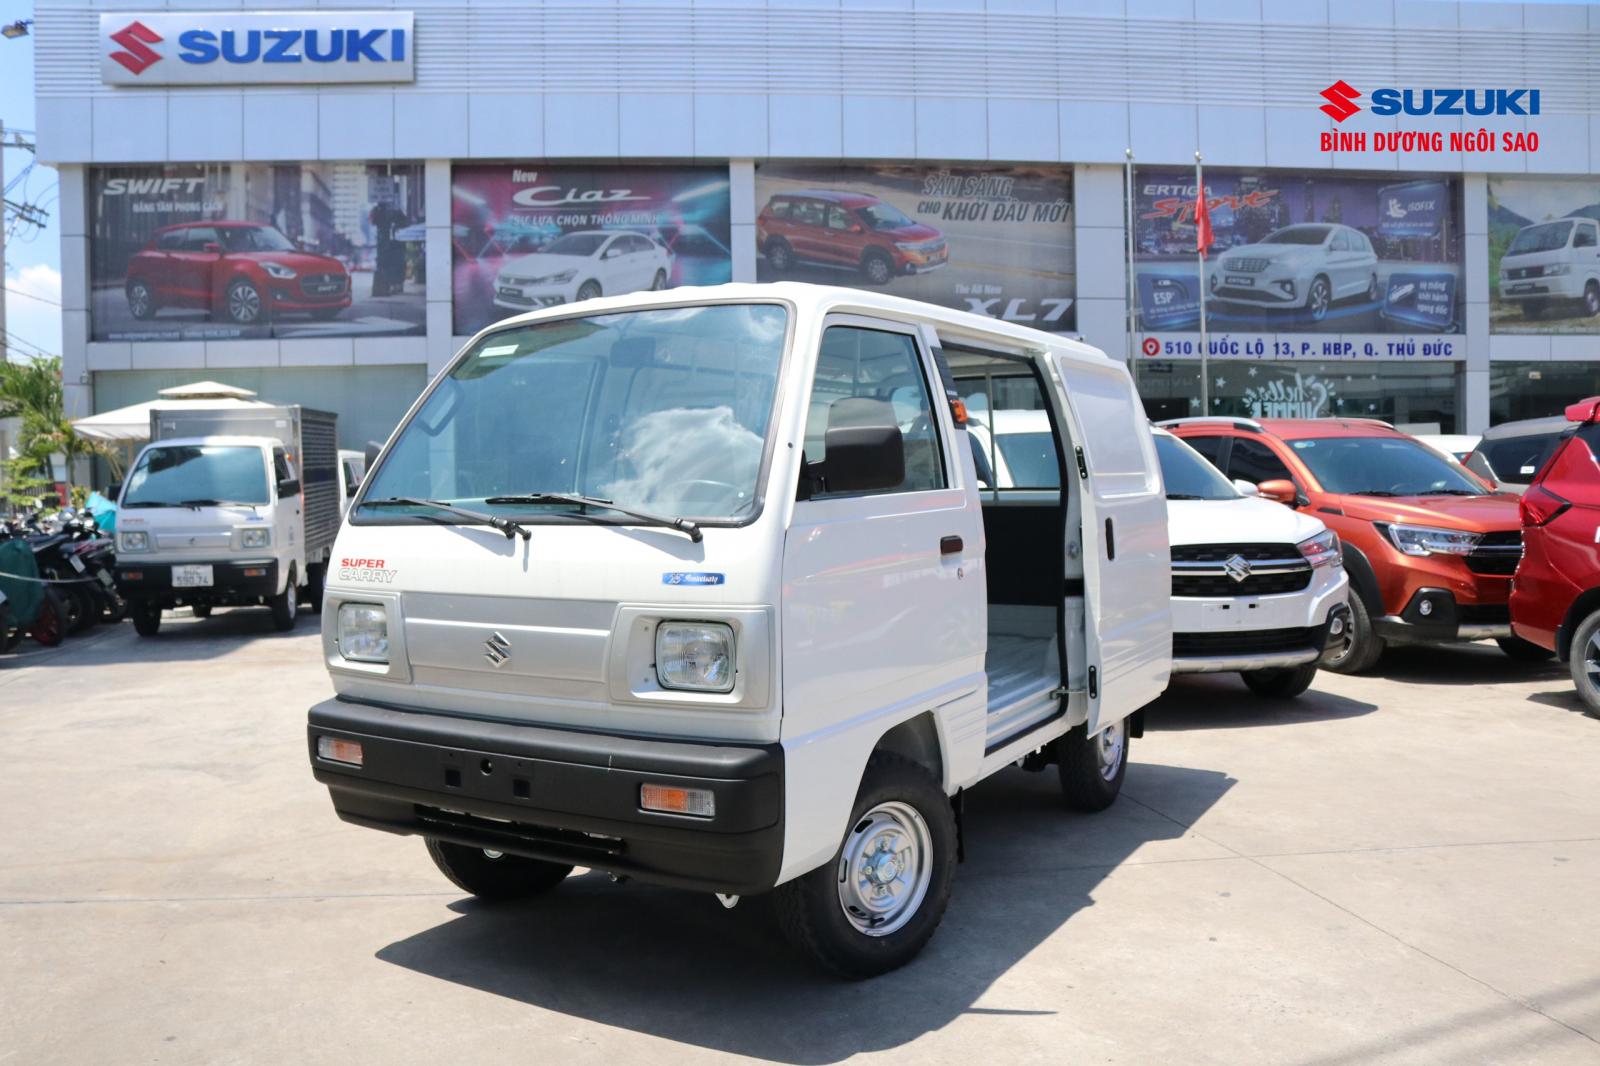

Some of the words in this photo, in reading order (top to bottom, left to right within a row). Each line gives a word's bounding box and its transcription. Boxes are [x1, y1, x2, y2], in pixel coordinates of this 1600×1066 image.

[178, 29, 405, 64] SUZUKI
[103, 178, 205, 195] SWIFT
[512, 169, 537, 183] New
[963, 172, 1014, 197] SÀNG
[513, 186, 653, 207] Ciaz
[556, 215, 588, 227] CHỌN
[591, 212, 629, 225] THÔNG
[917, 201, 942, 214] CHO
[992, 198, 1030, 222] ĐẦU
[1032, 198, 1072, 223] MỚI
[964, 298, 1074, 321] XL7
[1165, 341, 1193, 355] 510
[1199, 335, 1239, 356] UỐC
[1246, 338, 1265, 358] LỘ
[1274, 341, 1295, 358] 13,
[1301, 342, 1316, 356] P.
[1323, 342, 1357, 358] HBP,
[1364, 342, 1379, 357] Q.
[1387, 337, 1416, 357] THỦ
[1423, 338, 1453, 357] ĐỨC
[341, 558, 385, 568] SUPER
[338, 568, 398, 583] CARRY
